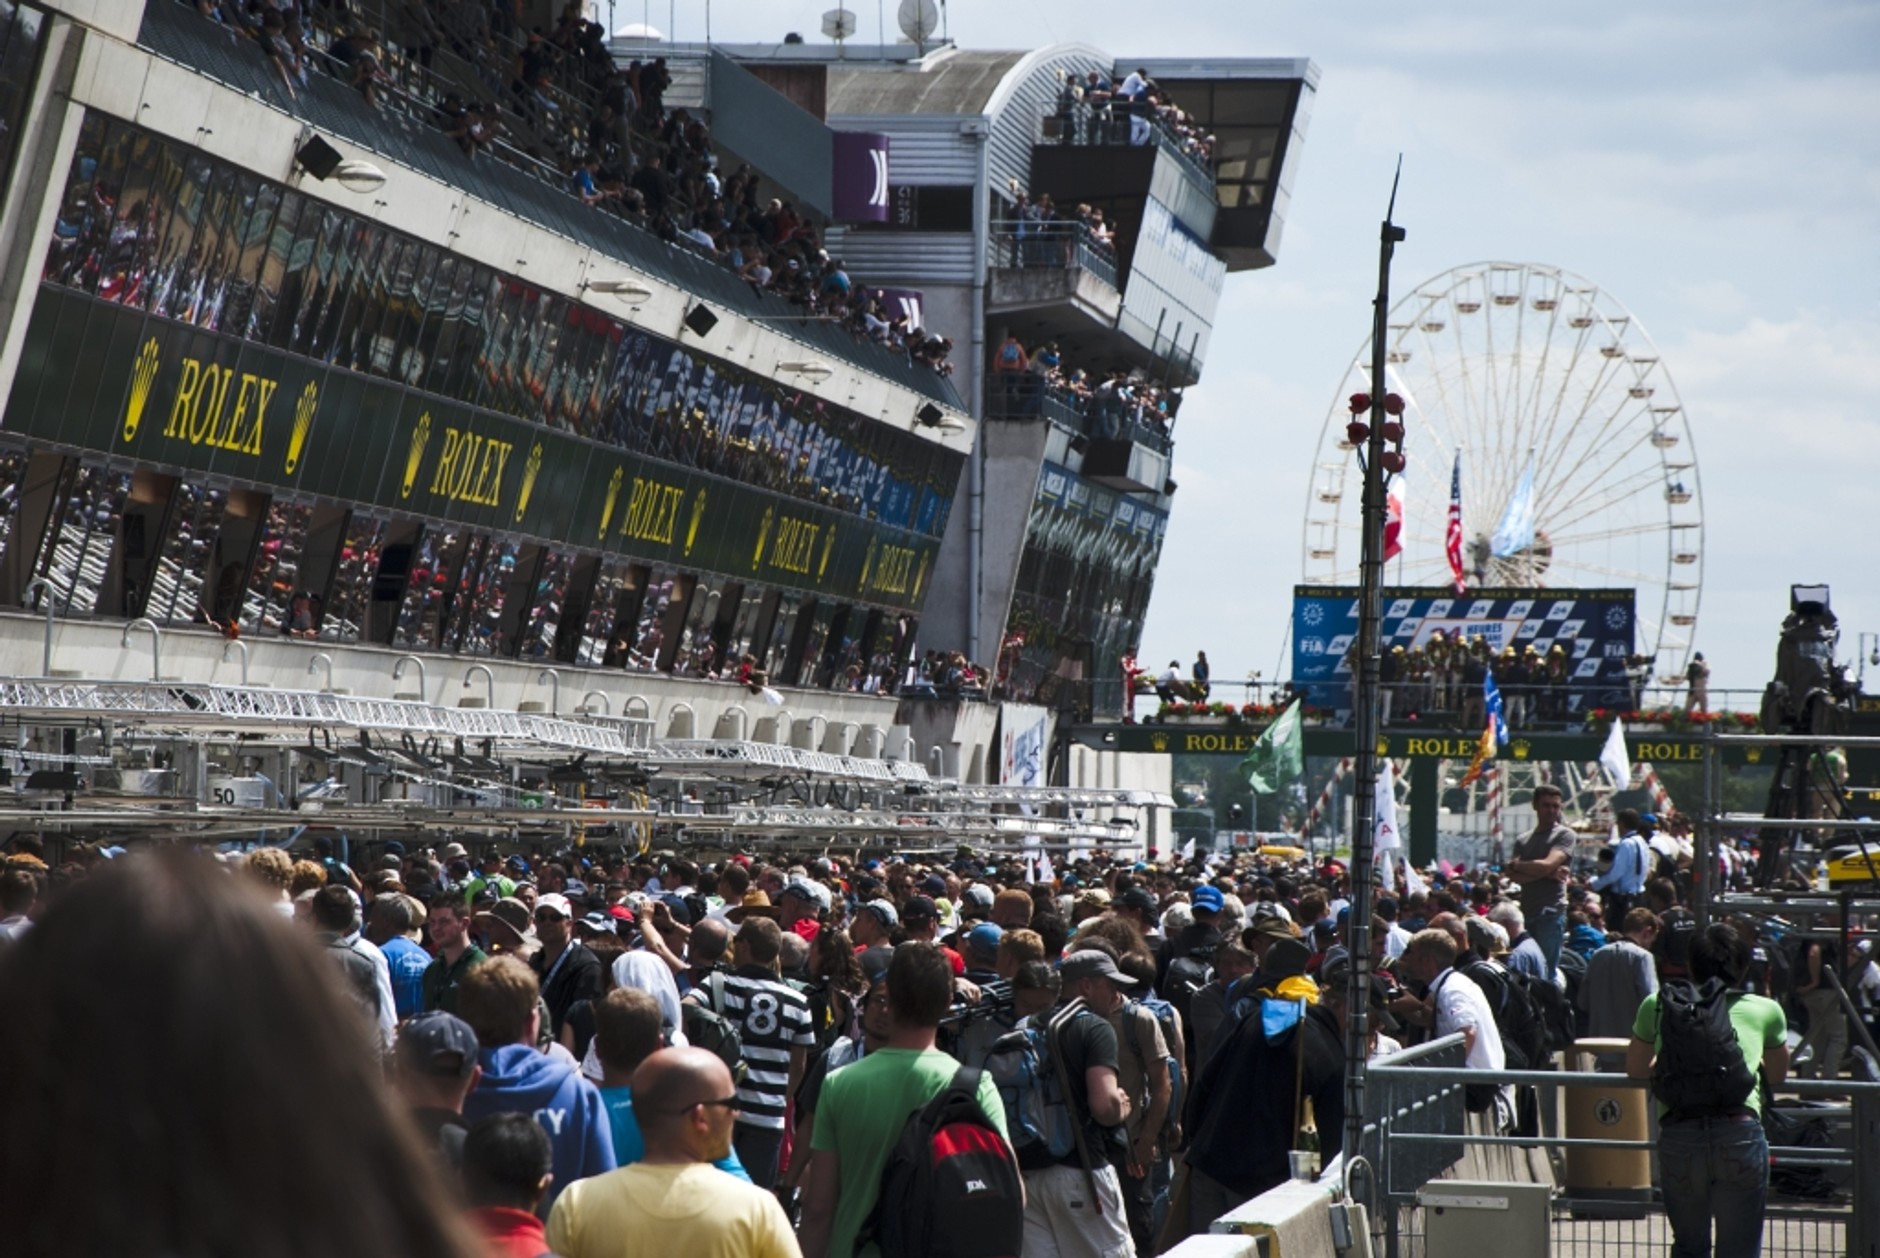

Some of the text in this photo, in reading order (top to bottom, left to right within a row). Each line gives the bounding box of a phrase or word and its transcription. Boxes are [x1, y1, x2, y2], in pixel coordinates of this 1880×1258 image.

[163, 357, 278, 455] ROLEX
[430, 427, 513, 507] ROLEX
[619, 477, 684, 544] ROLEX
[769, 515, 820, 575] ROLEX
[1392, 604, 1408, 613] 24
[1432, 604, 1447, 613] 24
[1471, 605, 1486, 614] 24
[1512, 606, 1527, 615] 24
[1552, 606, 1567, 615] 24
[1401, 623, 1416, 632] 24
[1521, 625, 1535, 633] 24
[1300, 639, 1325, 654] FIA
[1604, 644, 1628, 657] FIA
[1581, 663, 1595, 672] 24
[1636, 743, 1715, 760] ROLE
[213, 788, 235, 805] 50
[747, 992, 778, 1035] 8
